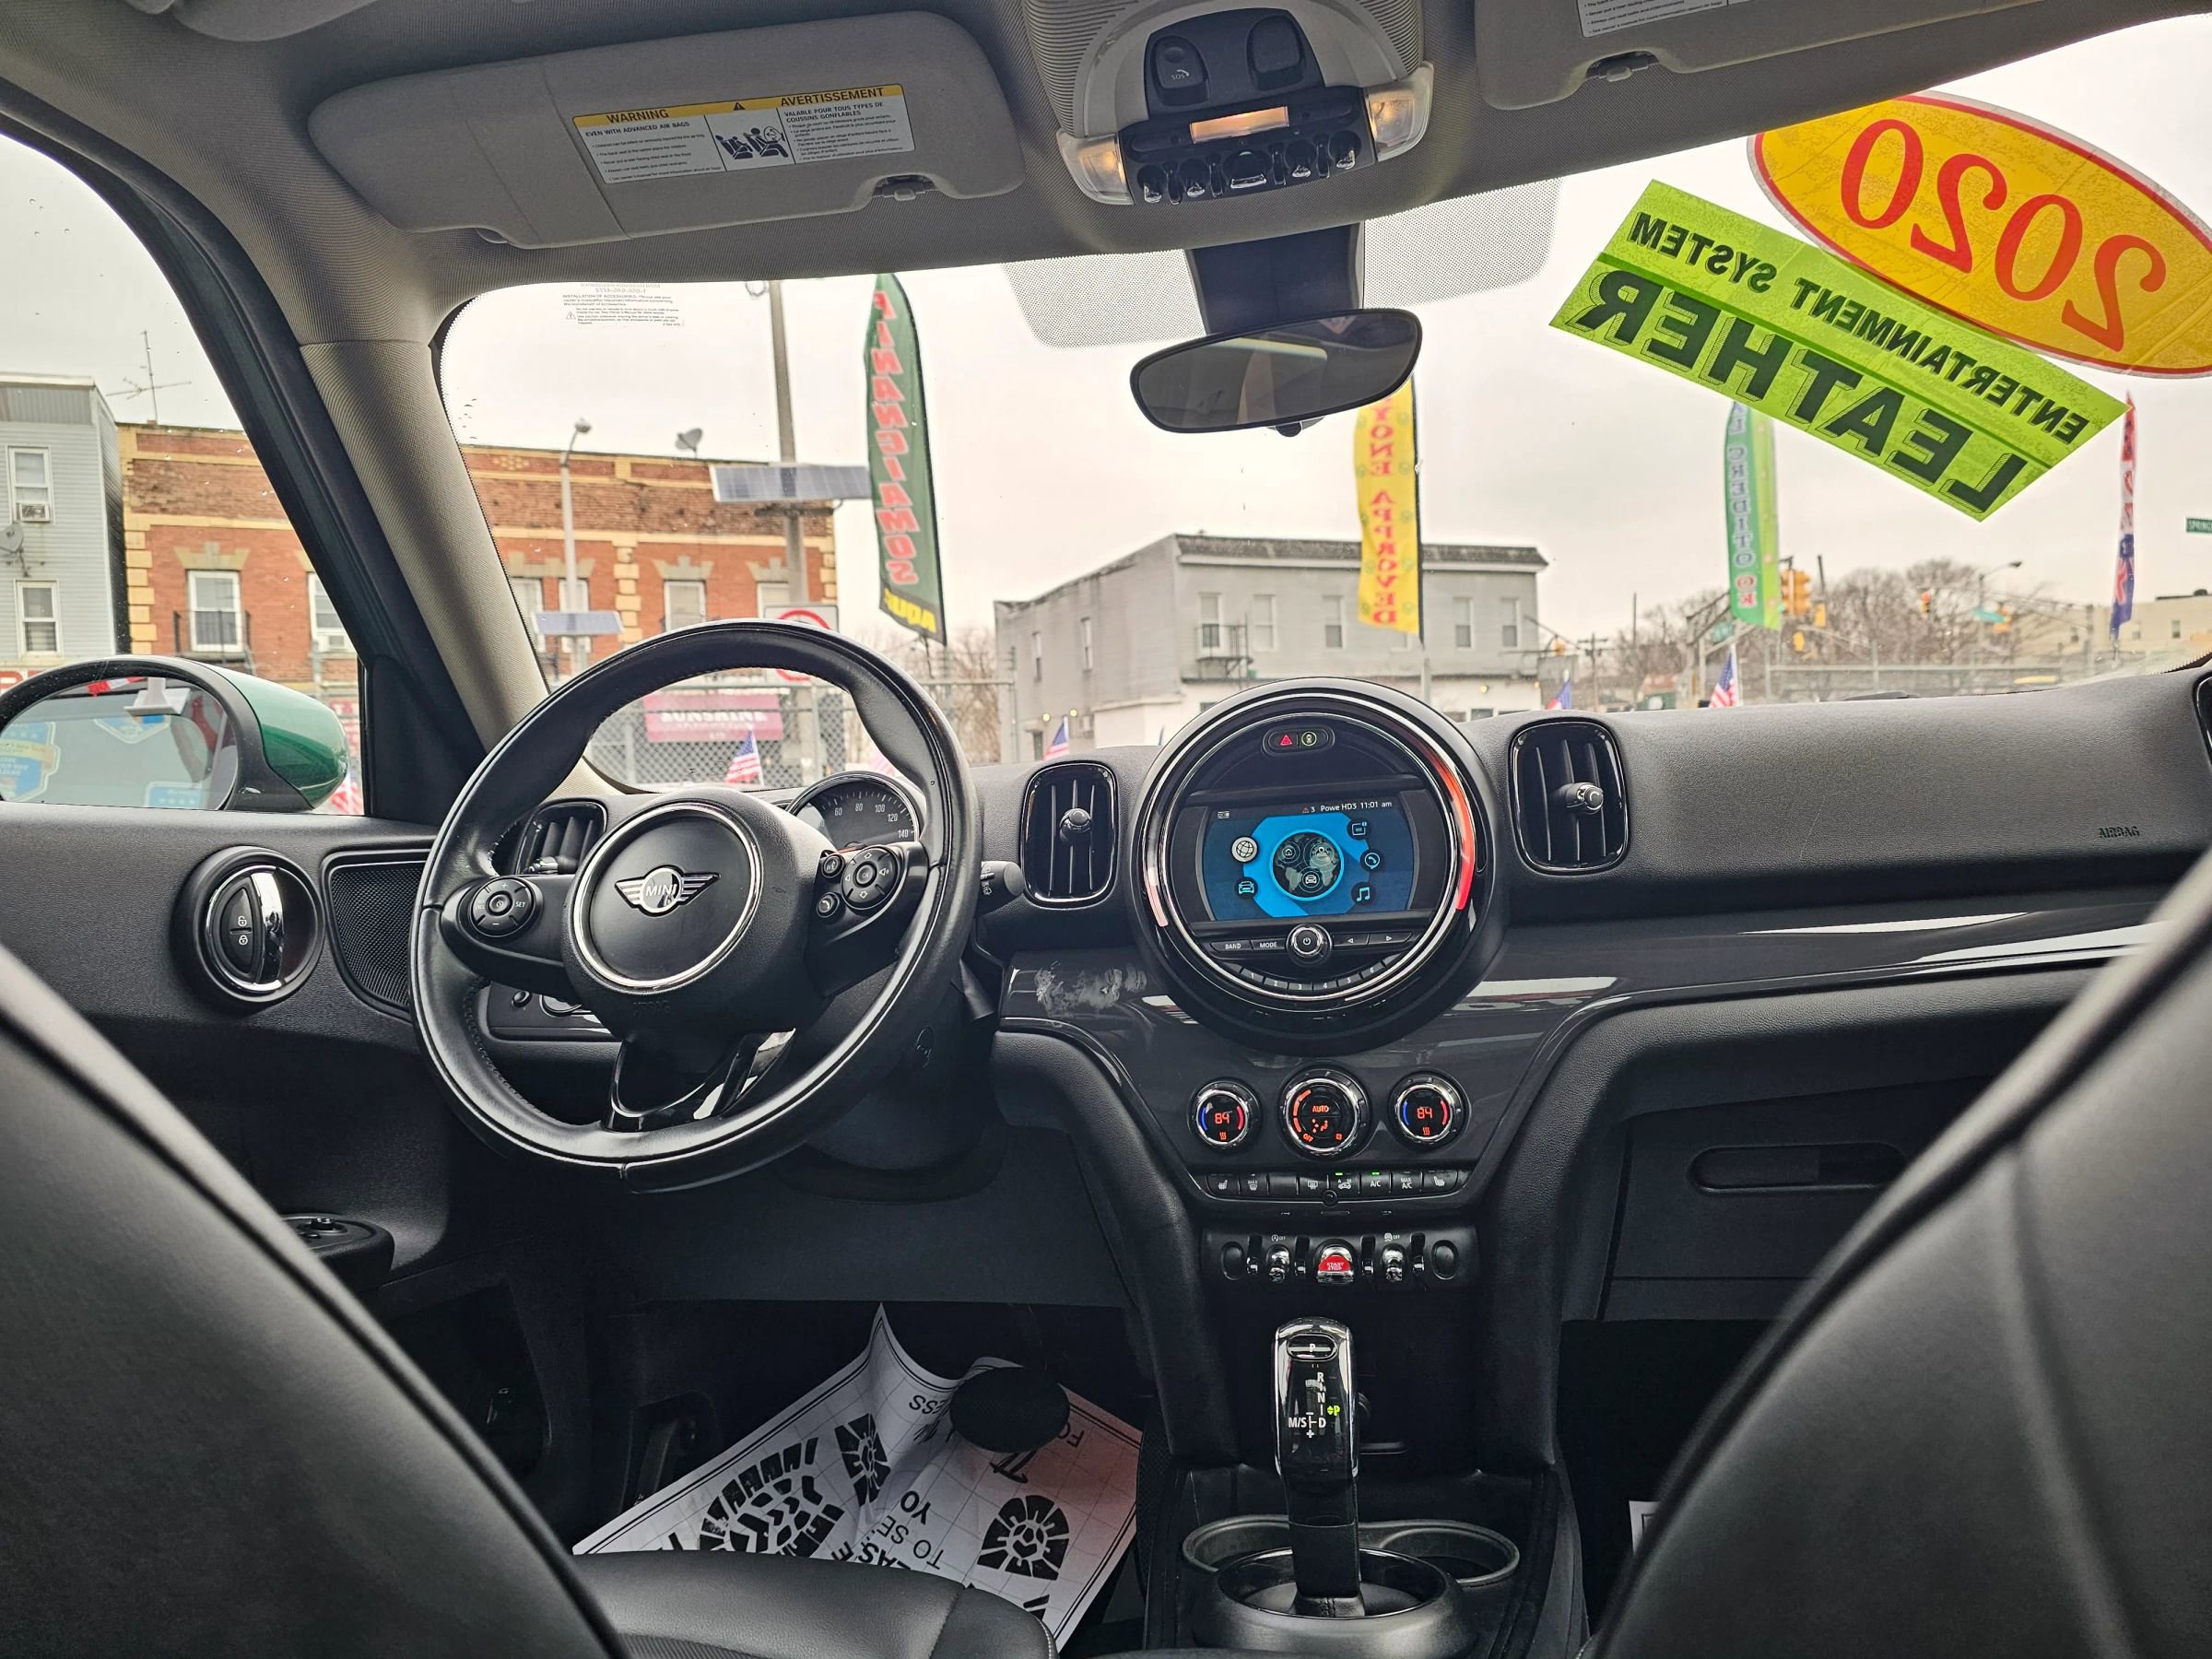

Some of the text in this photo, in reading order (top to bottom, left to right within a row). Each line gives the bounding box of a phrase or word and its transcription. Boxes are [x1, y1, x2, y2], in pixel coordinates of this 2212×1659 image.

[781, 88, 885, 107] AVERTISSEMENT
[784, 108, 812, 117] VALABLE
[834, 104, 851, 112] TOUS
[606, 110, 669, 124] WARNING
[786, 115, 819, 124] COUSSINS
[623, 124, 658, 133] ADVANCED
[2188, 520, 2212, 532] SPRING
[834, 807, 842, 817] 60
[855, 803, 864, 812] 80
[875, 804, 885, 813] 100
[887, 813, 899, 822] 120
[898, 830, 909, 839] 140
[645, 883, 677, 898] MINI
[1225, 942, 1241, 950] BAND
[1259, 941, 1277, 949] MODE
[1312, 1105, 1330, 1113] AUTO
[1417, 1107, 1433, 1119] 84
[1214, 1112, 1230, 1124] 84
[1309, 1343, 1316, 1353] P
[1317, 1371, 1324, 1382] R
[1317, 1392, 1325, 1403] N
[1288, 1417, 1307, 1429] M/S
[1318, 1417, 1327, 1429] D
[900, 1489, 932, 1525] YO
[912, 1538, 945, 1570] TO
